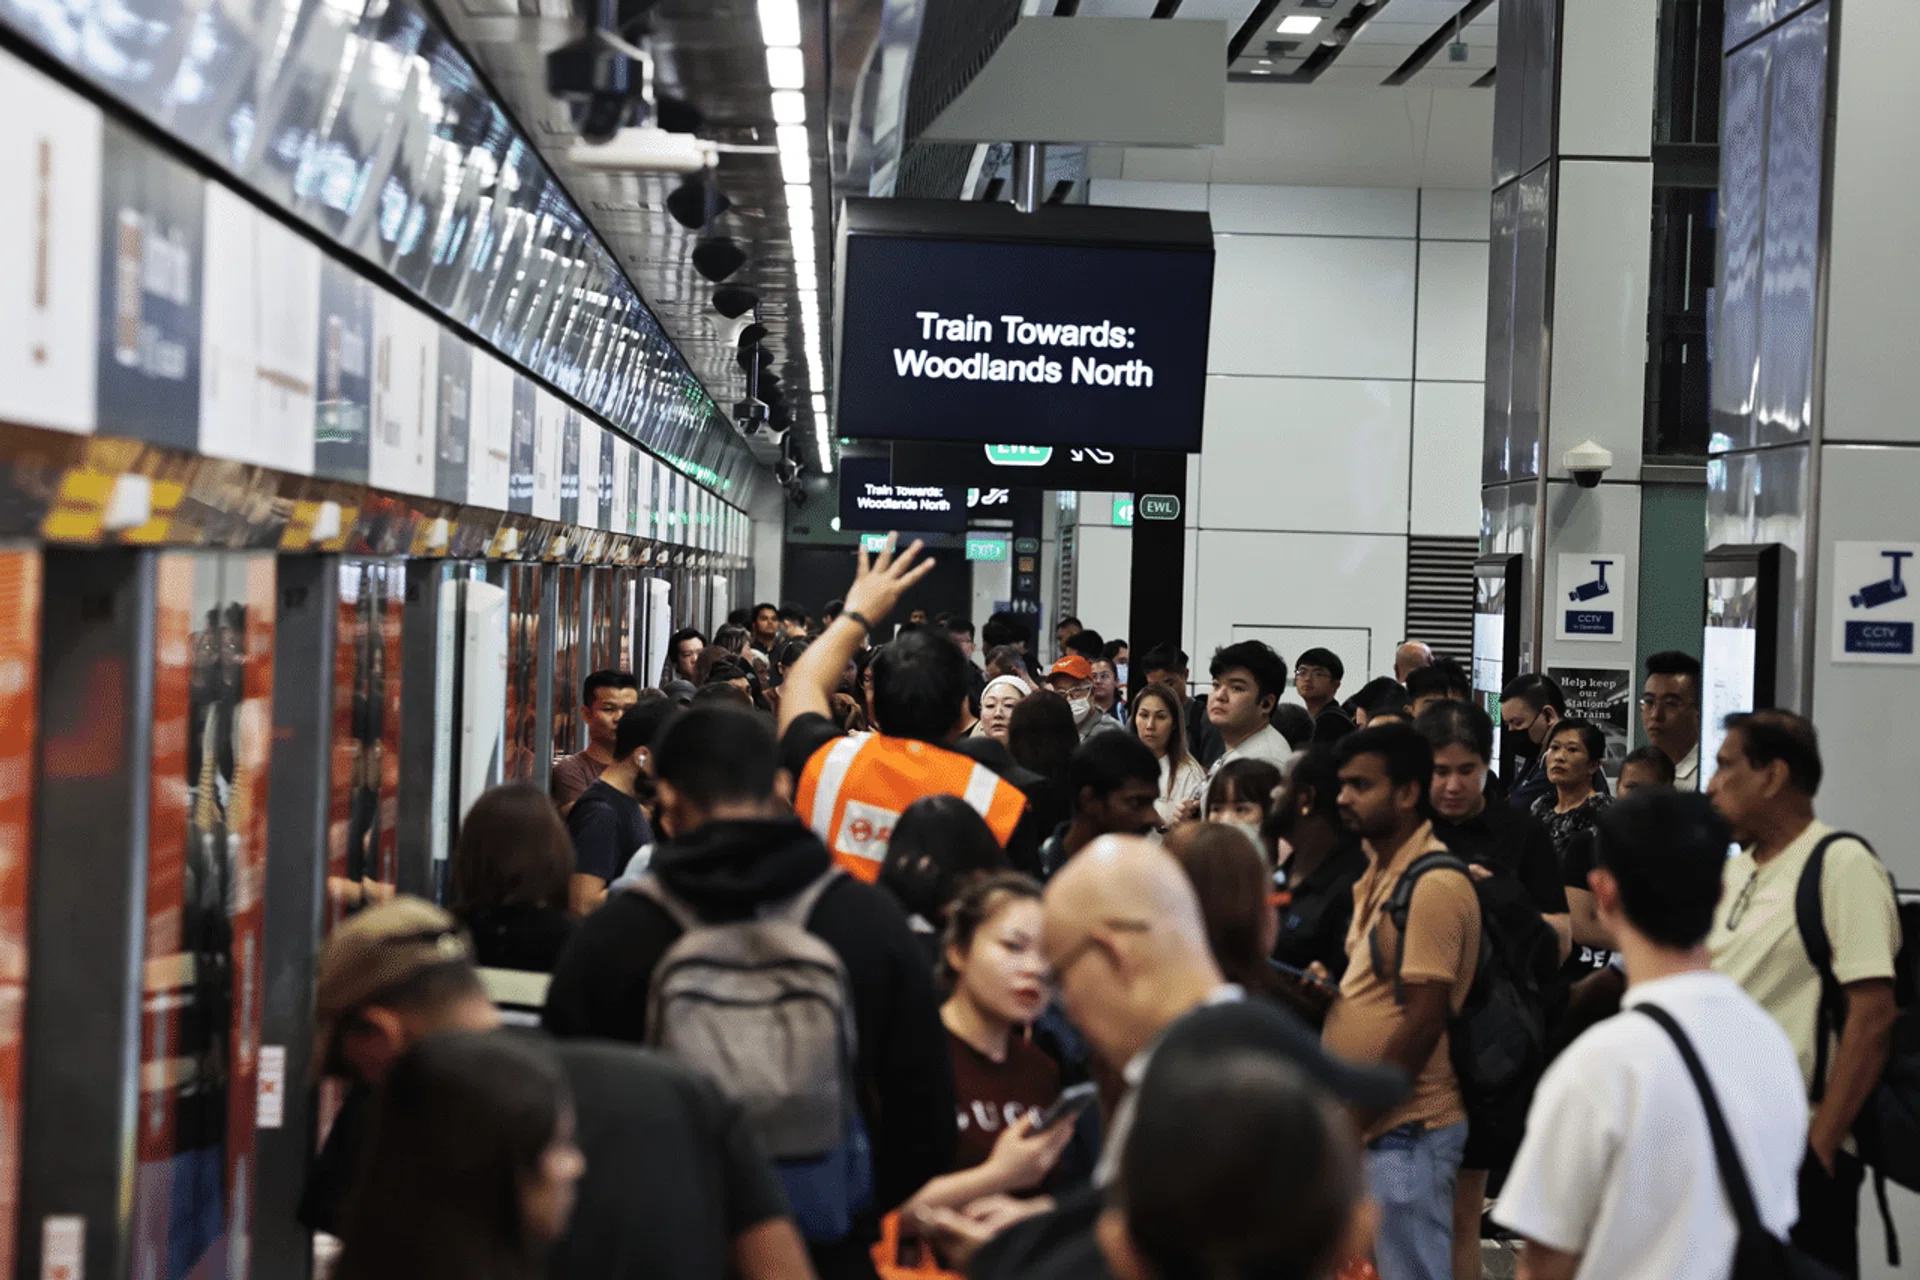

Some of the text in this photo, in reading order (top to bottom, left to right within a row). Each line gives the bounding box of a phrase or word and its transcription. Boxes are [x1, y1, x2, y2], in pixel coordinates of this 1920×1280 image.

[915, 311, 1136, 349] Train Towards:
[893, 348, 1154, 388] Woodlands North
[864, 483, 944, 498] Train Towards:
[857, 496, 951, 511] Woodlands North
[1147, 501, 1173, 513] EWL
[970, 543, 994, 557] EXIT
[1577, 614, 1602, 623] CCTV
[1862, 626, 1896, 638] CCTV
[1561, 677, 1617, 690] Help keep
[1579, 690, 1598, 698] our
[1565, 698, 1611, 709] Stations
[1563, 709, 1611, 720] & Trains
